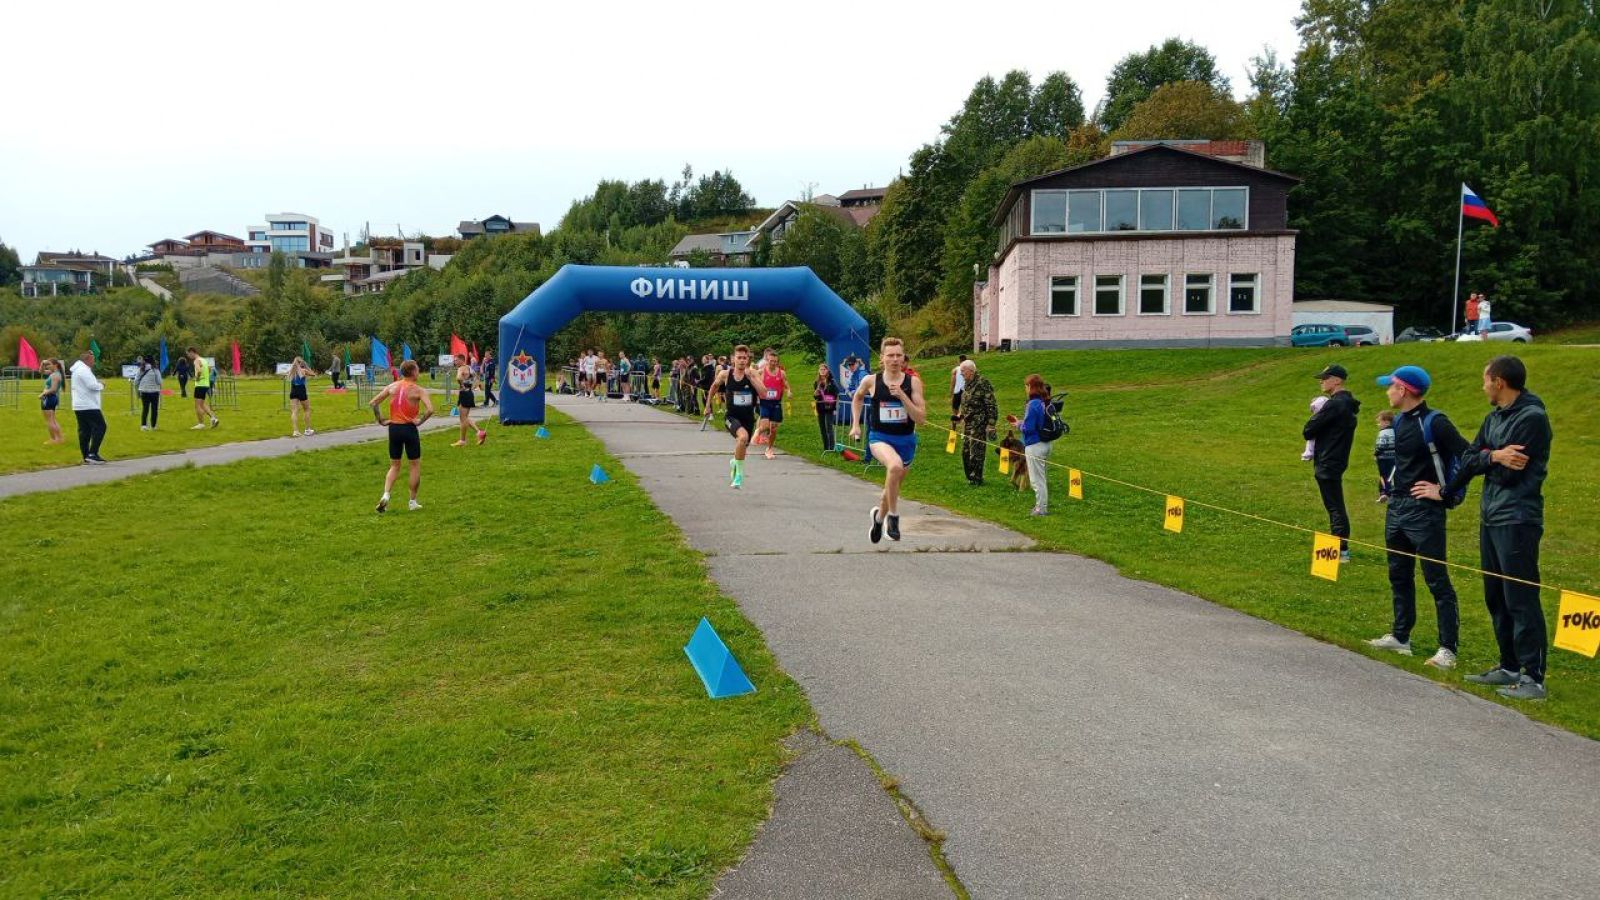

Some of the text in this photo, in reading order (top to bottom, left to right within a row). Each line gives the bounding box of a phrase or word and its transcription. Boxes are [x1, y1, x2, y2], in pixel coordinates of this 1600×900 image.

[630, 277, 749, 301] ФИНИШ
[887, 409, 900, 419] 11
[1316, 546, 1338, 562] TOKO
[1562, 610, 1600, 631] TOKO
